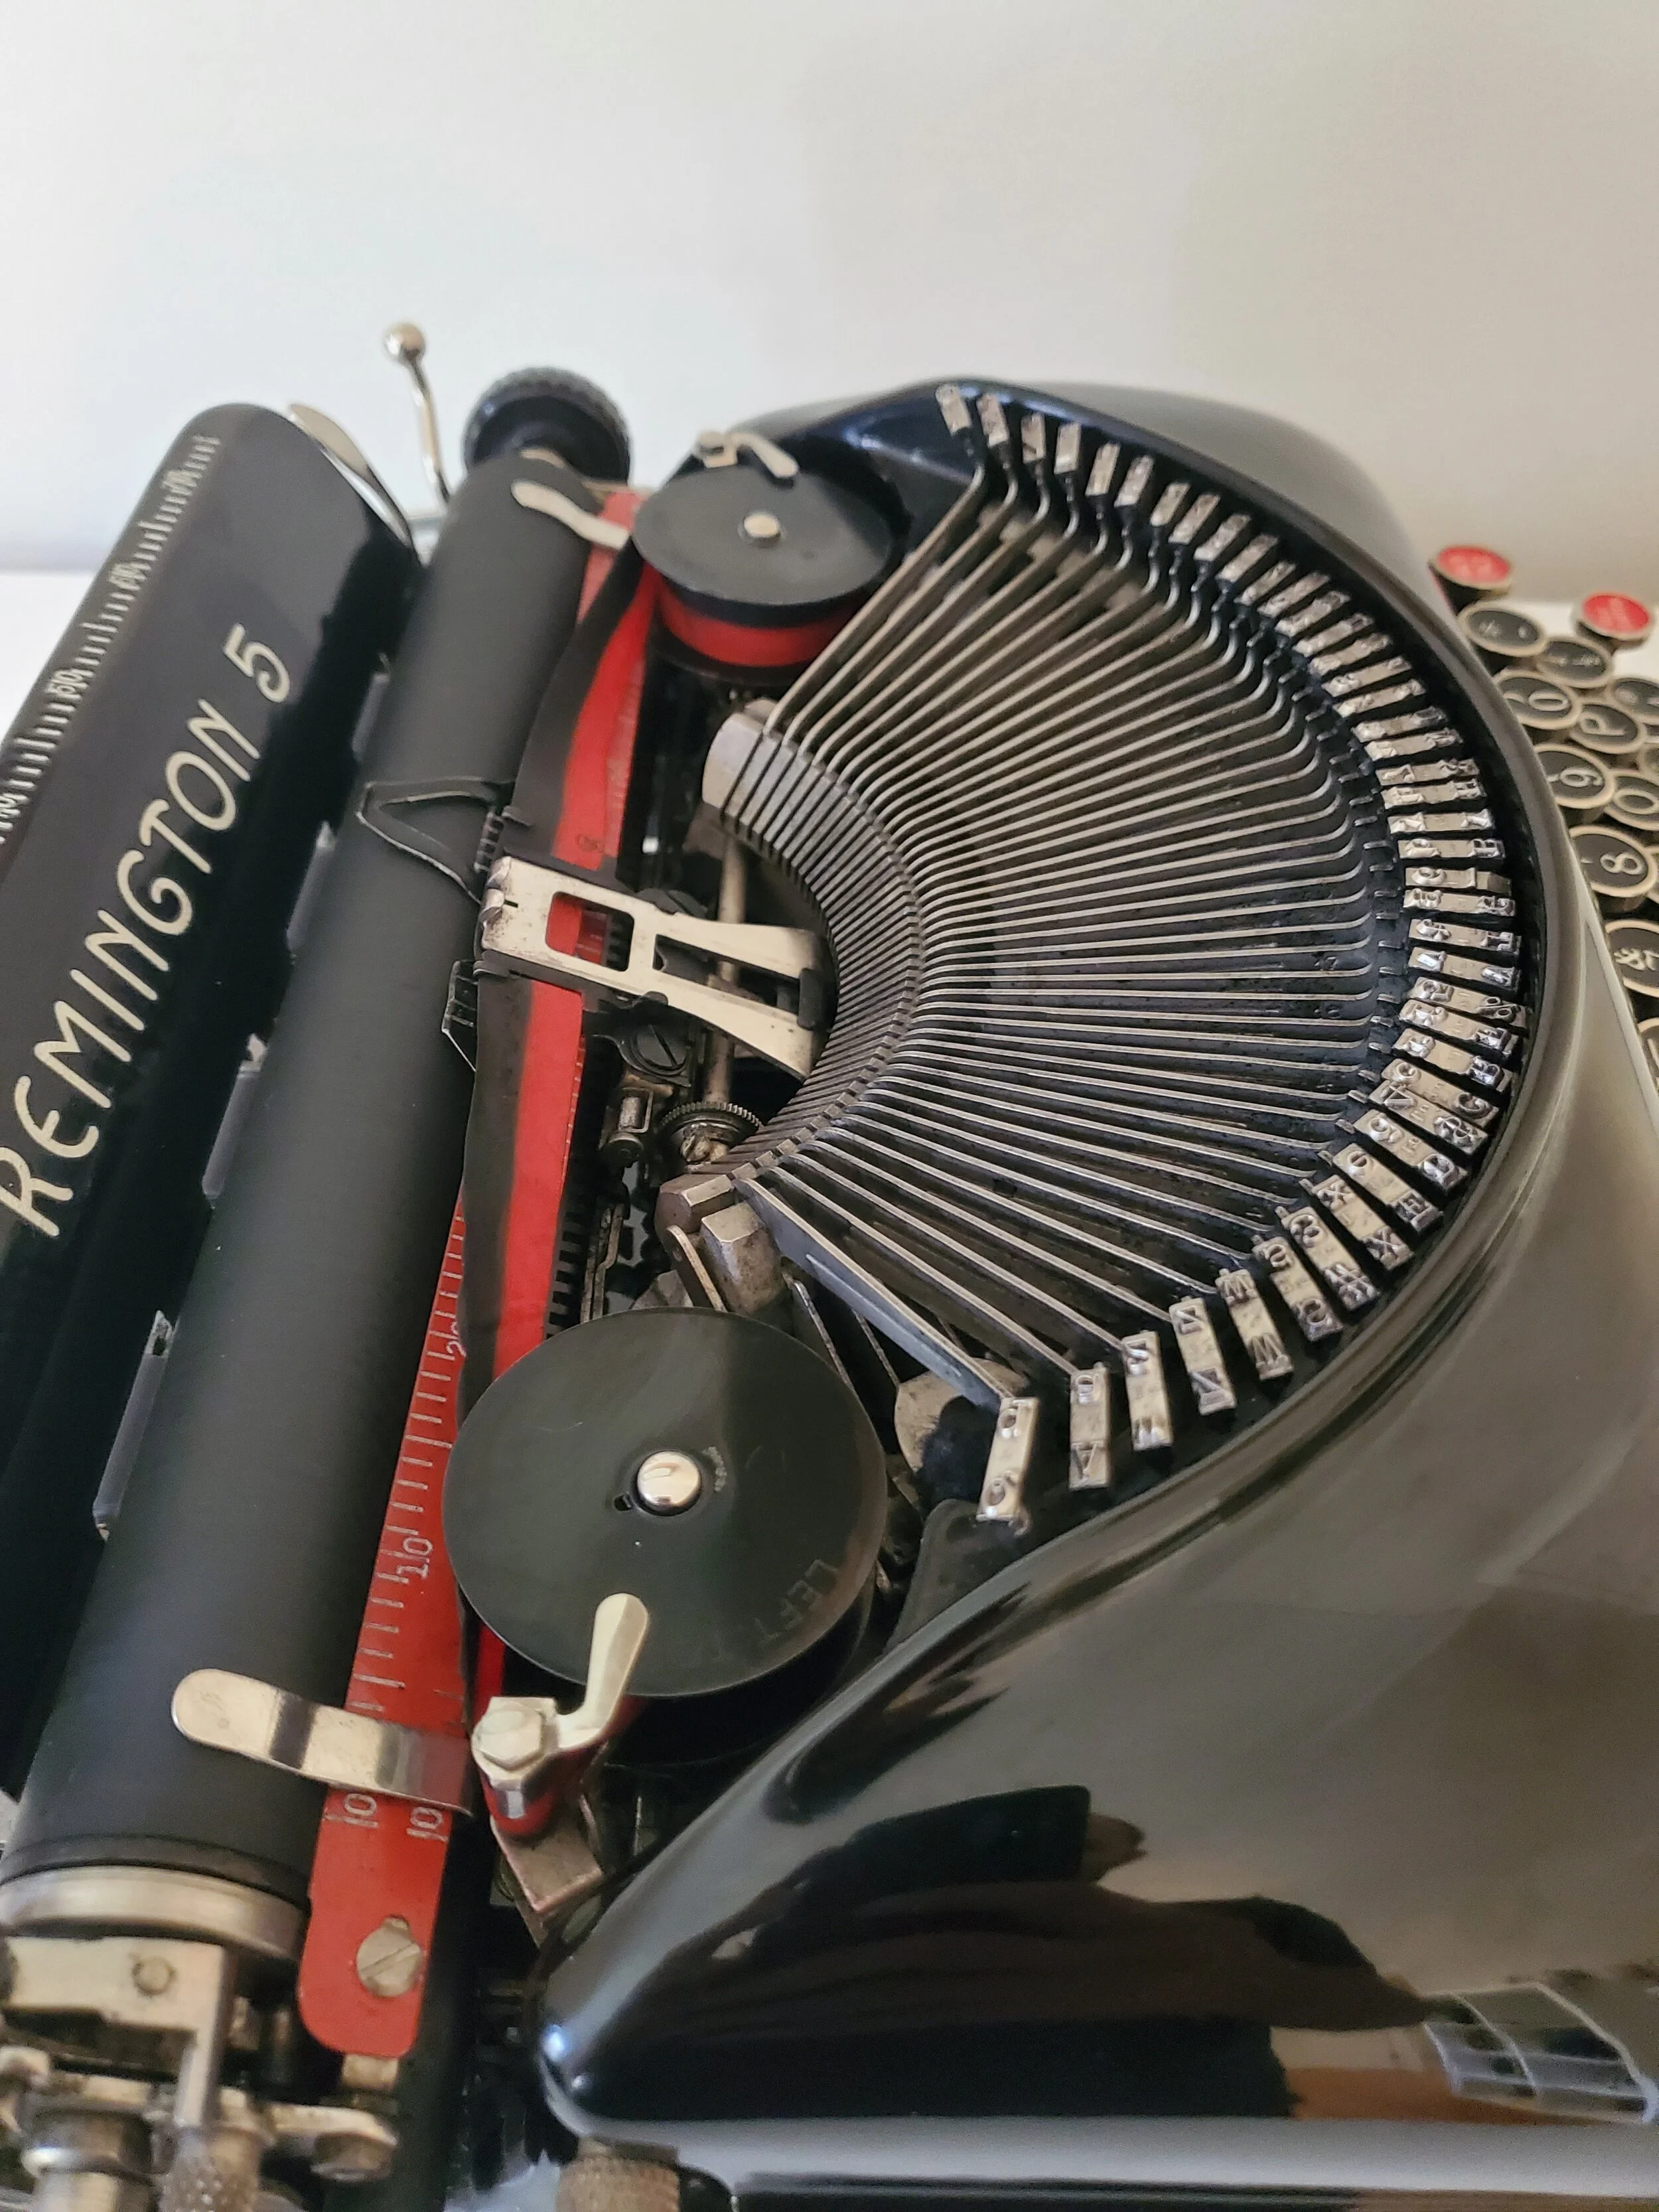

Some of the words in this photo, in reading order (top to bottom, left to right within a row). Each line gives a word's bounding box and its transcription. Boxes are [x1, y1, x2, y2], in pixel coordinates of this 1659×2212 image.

[1600, 853, 1644, 875] 8
[0, 698, 260, 1236] REMINGTON
[223, 623, 291, 703] 5
[396, 1537, 433, 1580] 10
[754, 1559, 840, 1643] LEFT
